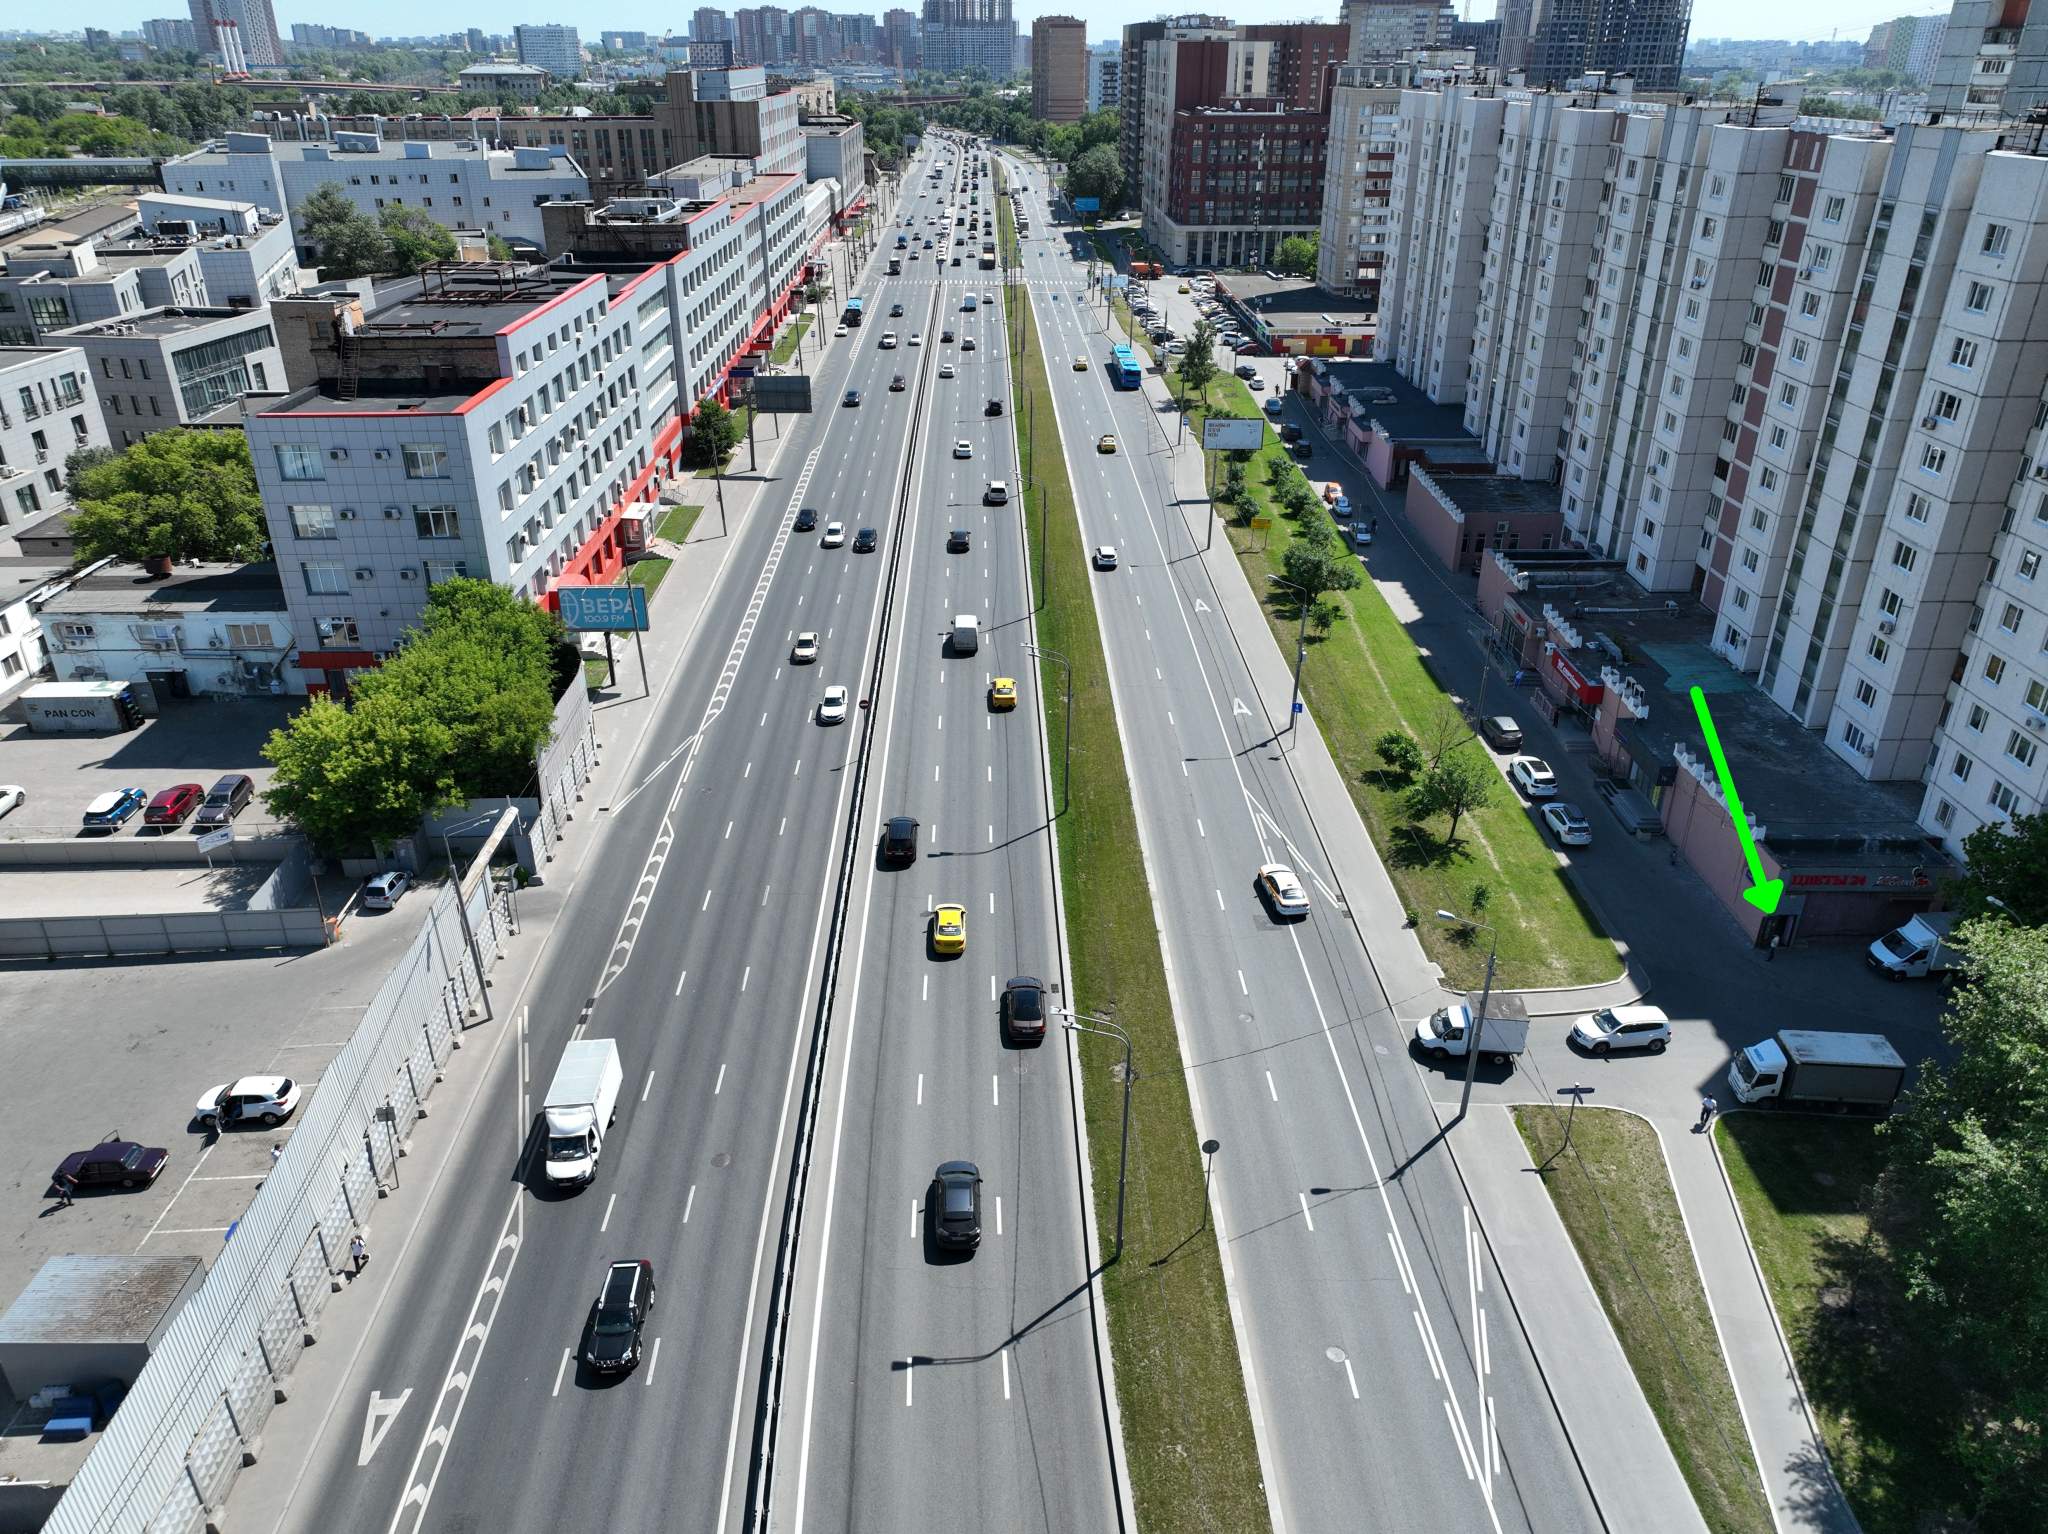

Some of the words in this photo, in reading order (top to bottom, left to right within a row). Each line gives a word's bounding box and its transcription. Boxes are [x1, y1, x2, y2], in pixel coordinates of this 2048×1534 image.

[583, 598, 637, 614] ВЕРА
[611, 614, 625, 623] FM
[44, 709, 68, 718] PAN
[70, 709, 96, 718] CON
